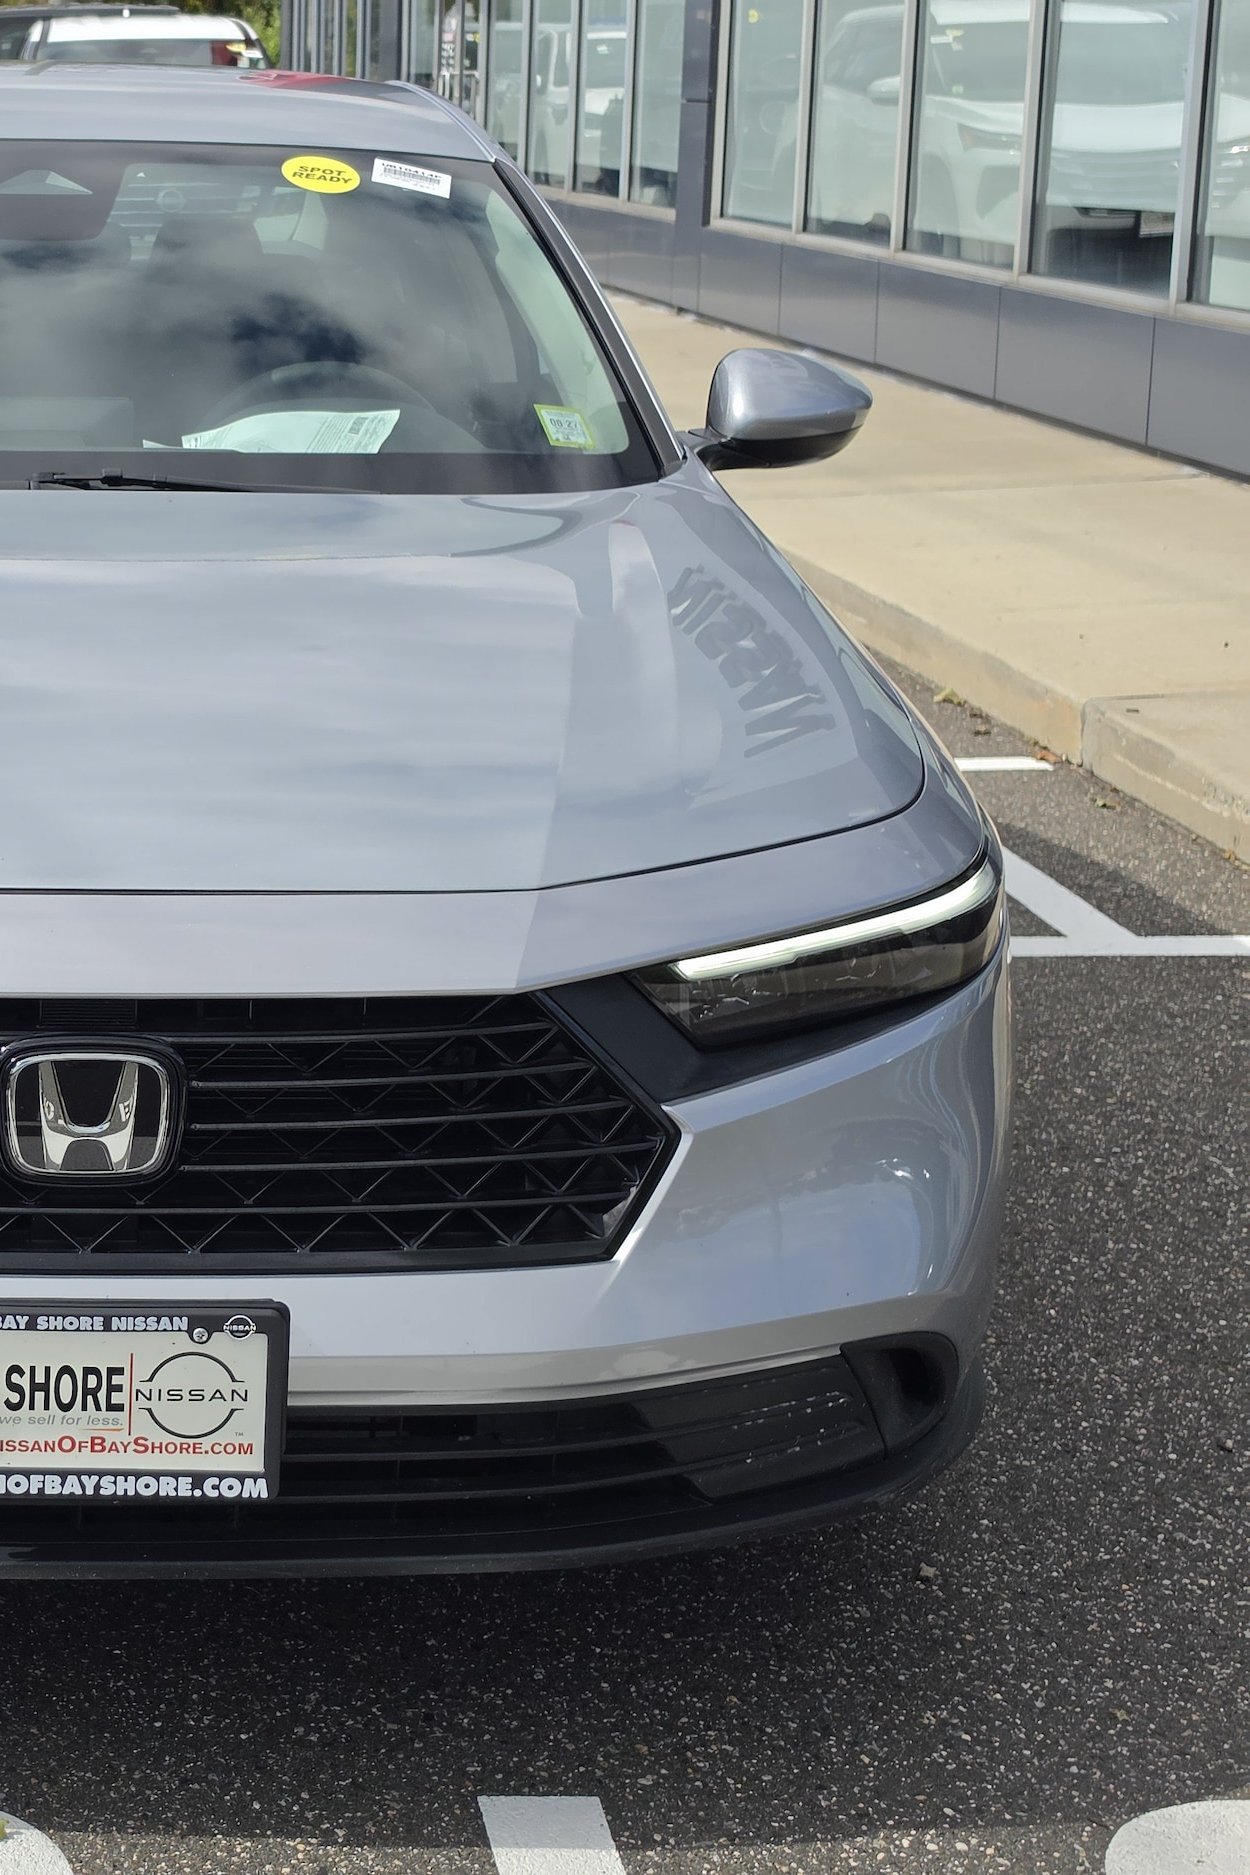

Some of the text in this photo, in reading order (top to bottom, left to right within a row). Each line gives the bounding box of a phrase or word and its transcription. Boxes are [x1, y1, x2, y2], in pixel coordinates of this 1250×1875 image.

[299, 165, 347, 176] SPOT
[291, 171, 353, 185] READY
[36, 1316, 105, 1331] SHORE
[111, 1316, 189, 1332] NISSAN
[222, 1324, 257, 1332] NISSAN
[3, 1364, 125, 1413] SHORE
[135, 1388, 249, 1403] NISSAN
[27, 1414, 56, 1426] sell
[60, 1414, 83, 1427] for
[86, 1415, 124, 1427] less.
